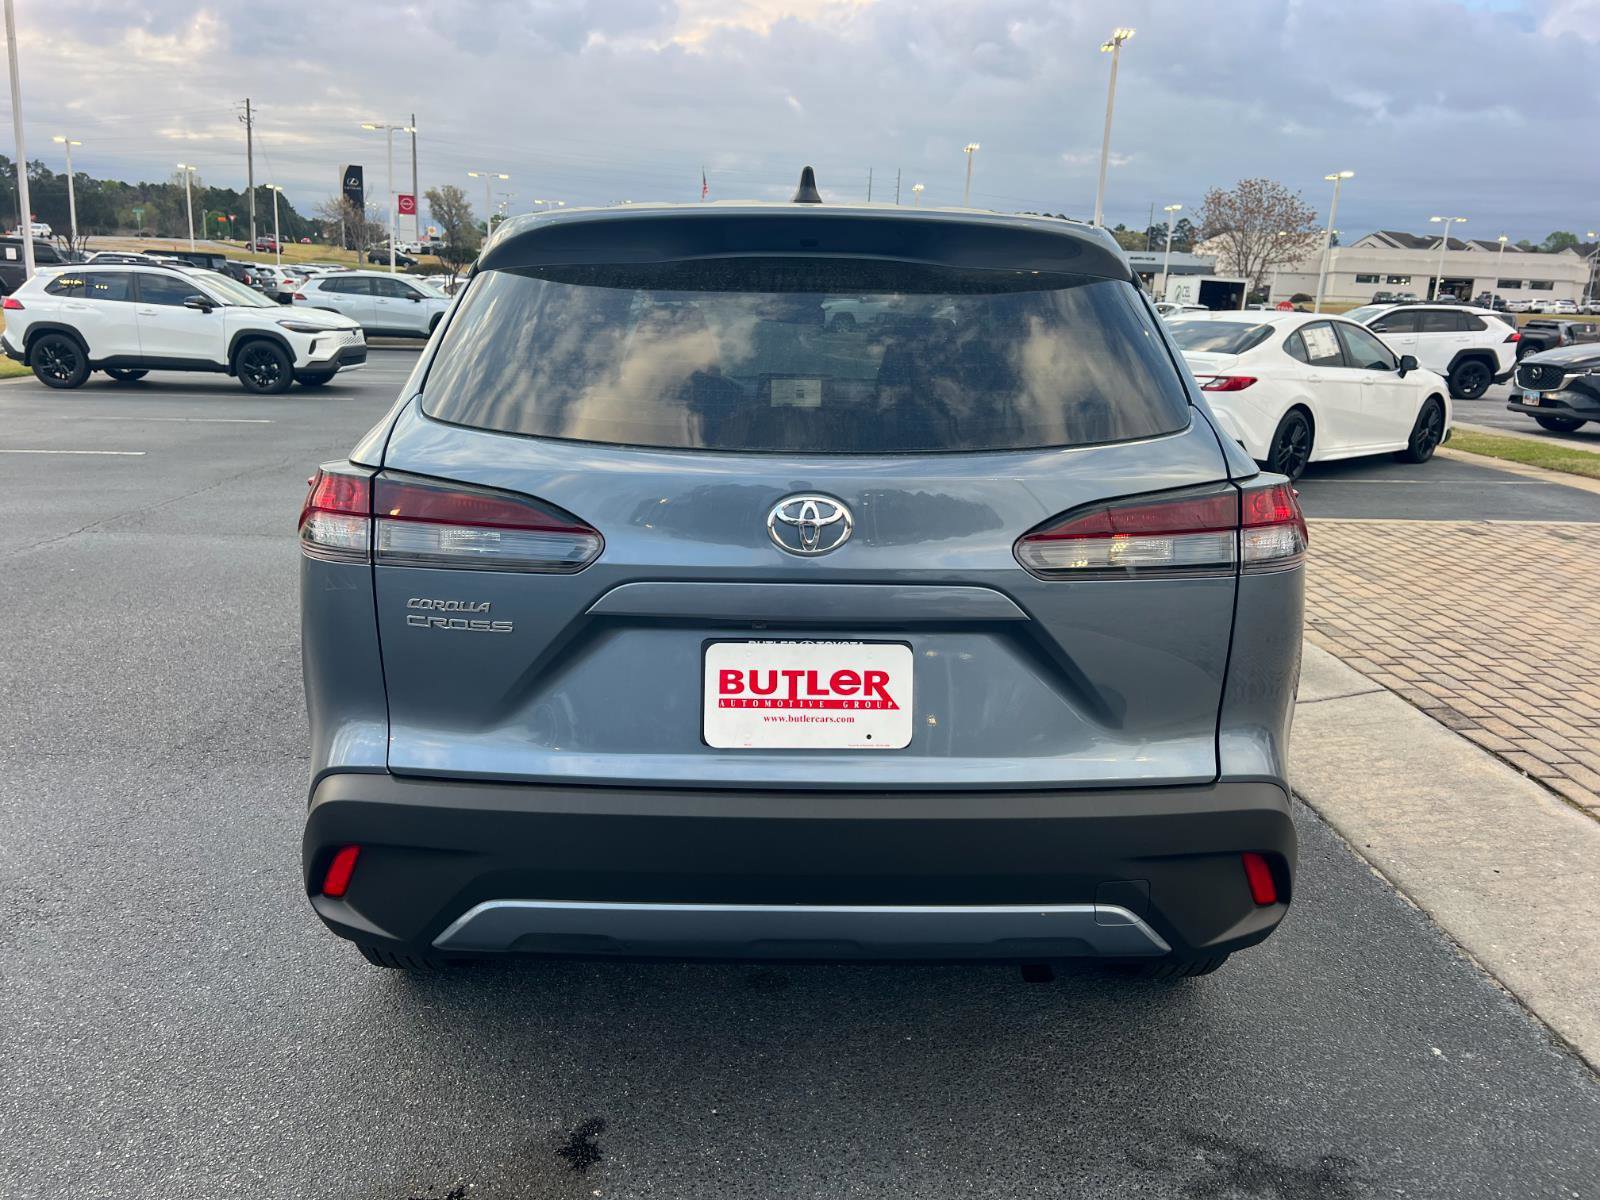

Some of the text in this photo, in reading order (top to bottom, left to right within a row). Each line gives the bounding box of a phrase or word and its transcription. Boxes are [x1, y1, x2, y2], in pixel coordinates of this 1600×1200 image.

[406, 598, 491, 613] COROLLA
[406, 614, 513, 633] CROSS
[719, 699, 894, 709] AUTOMOTIVE GROUP
[763, 714, 855, 723] www.butlercars.com
